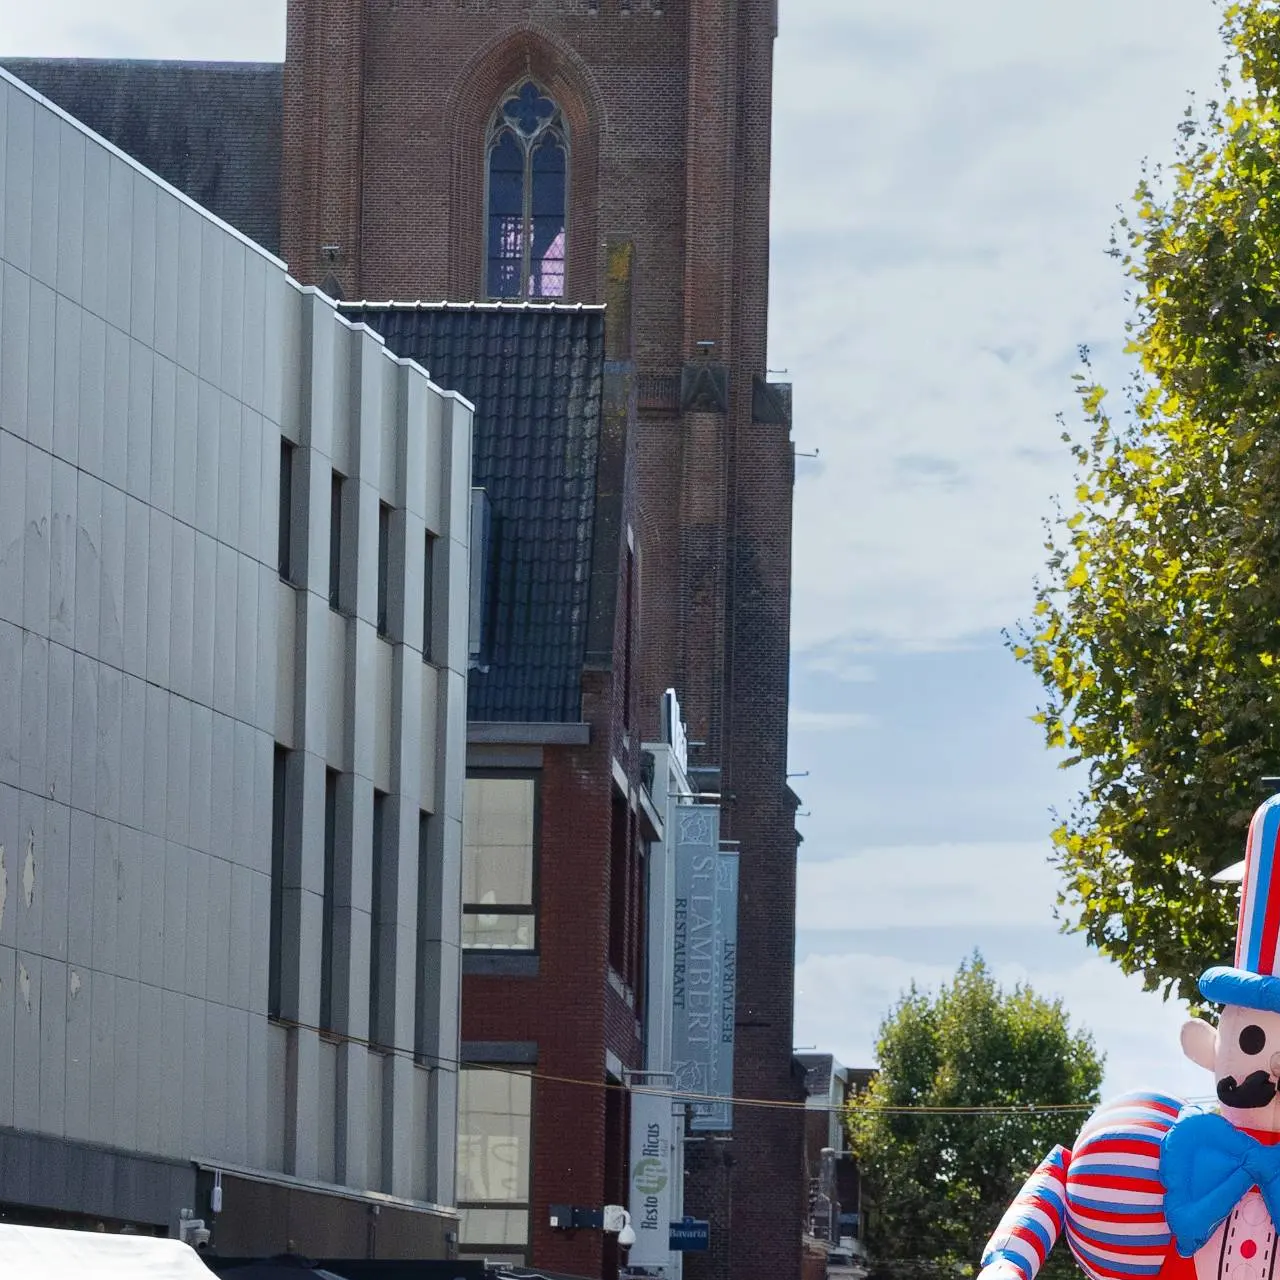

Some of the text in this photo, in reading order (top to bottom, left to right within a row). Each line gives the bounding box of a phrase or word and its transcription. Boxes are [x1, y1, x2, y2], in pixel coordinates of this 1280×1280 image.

[673, 897, 688, 1011] RESTAURANT
[687, 854, 715, 1050] St. LAMBERT
[721, 938, 736, 1045] RESTAURANT
[641, 1122, 661, 1158] Ricus
[640, 1195, 659, 1231] Resto
[669, 1228, 708, 1239] Bavaria
